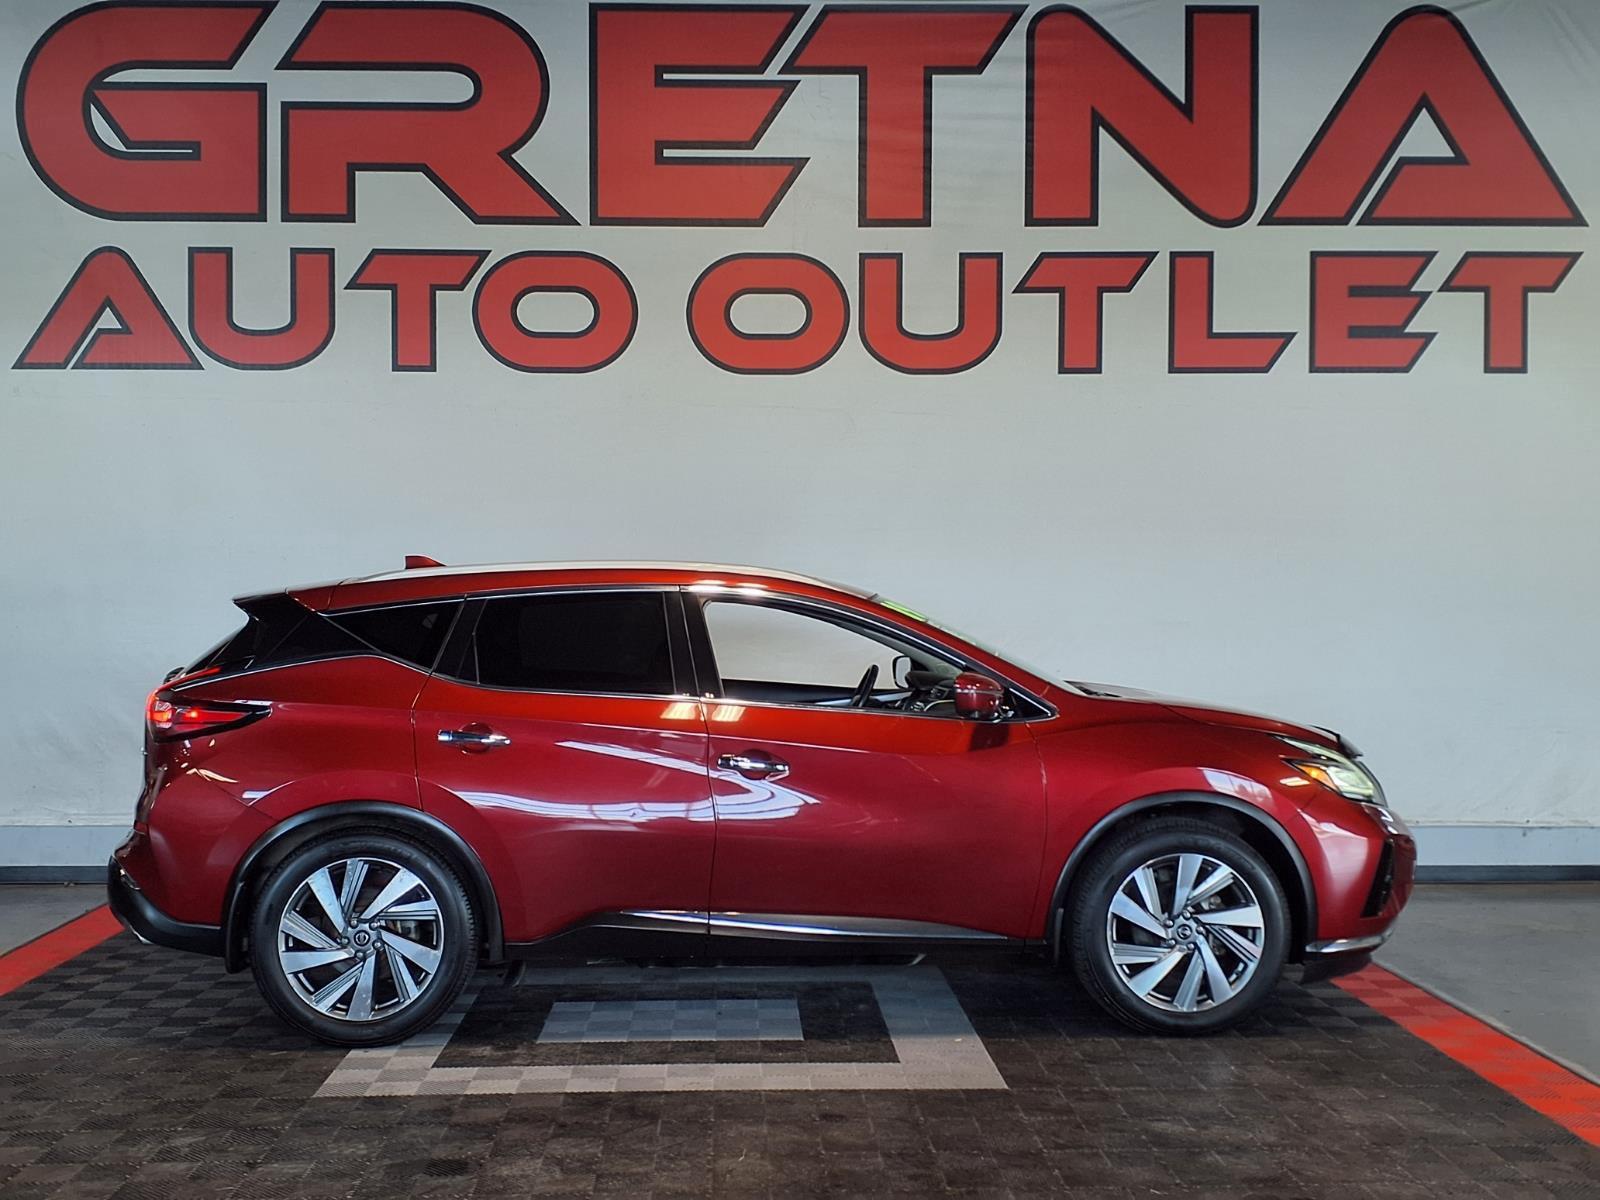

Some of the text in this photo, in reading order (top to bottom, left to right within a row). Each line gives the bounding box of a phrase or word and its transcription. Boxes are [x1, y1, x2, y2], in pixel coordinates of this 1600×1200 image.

[16, 0, 1588, 228] GRETNA
[12, 245, 1582, 375] AUTO OUTLET
